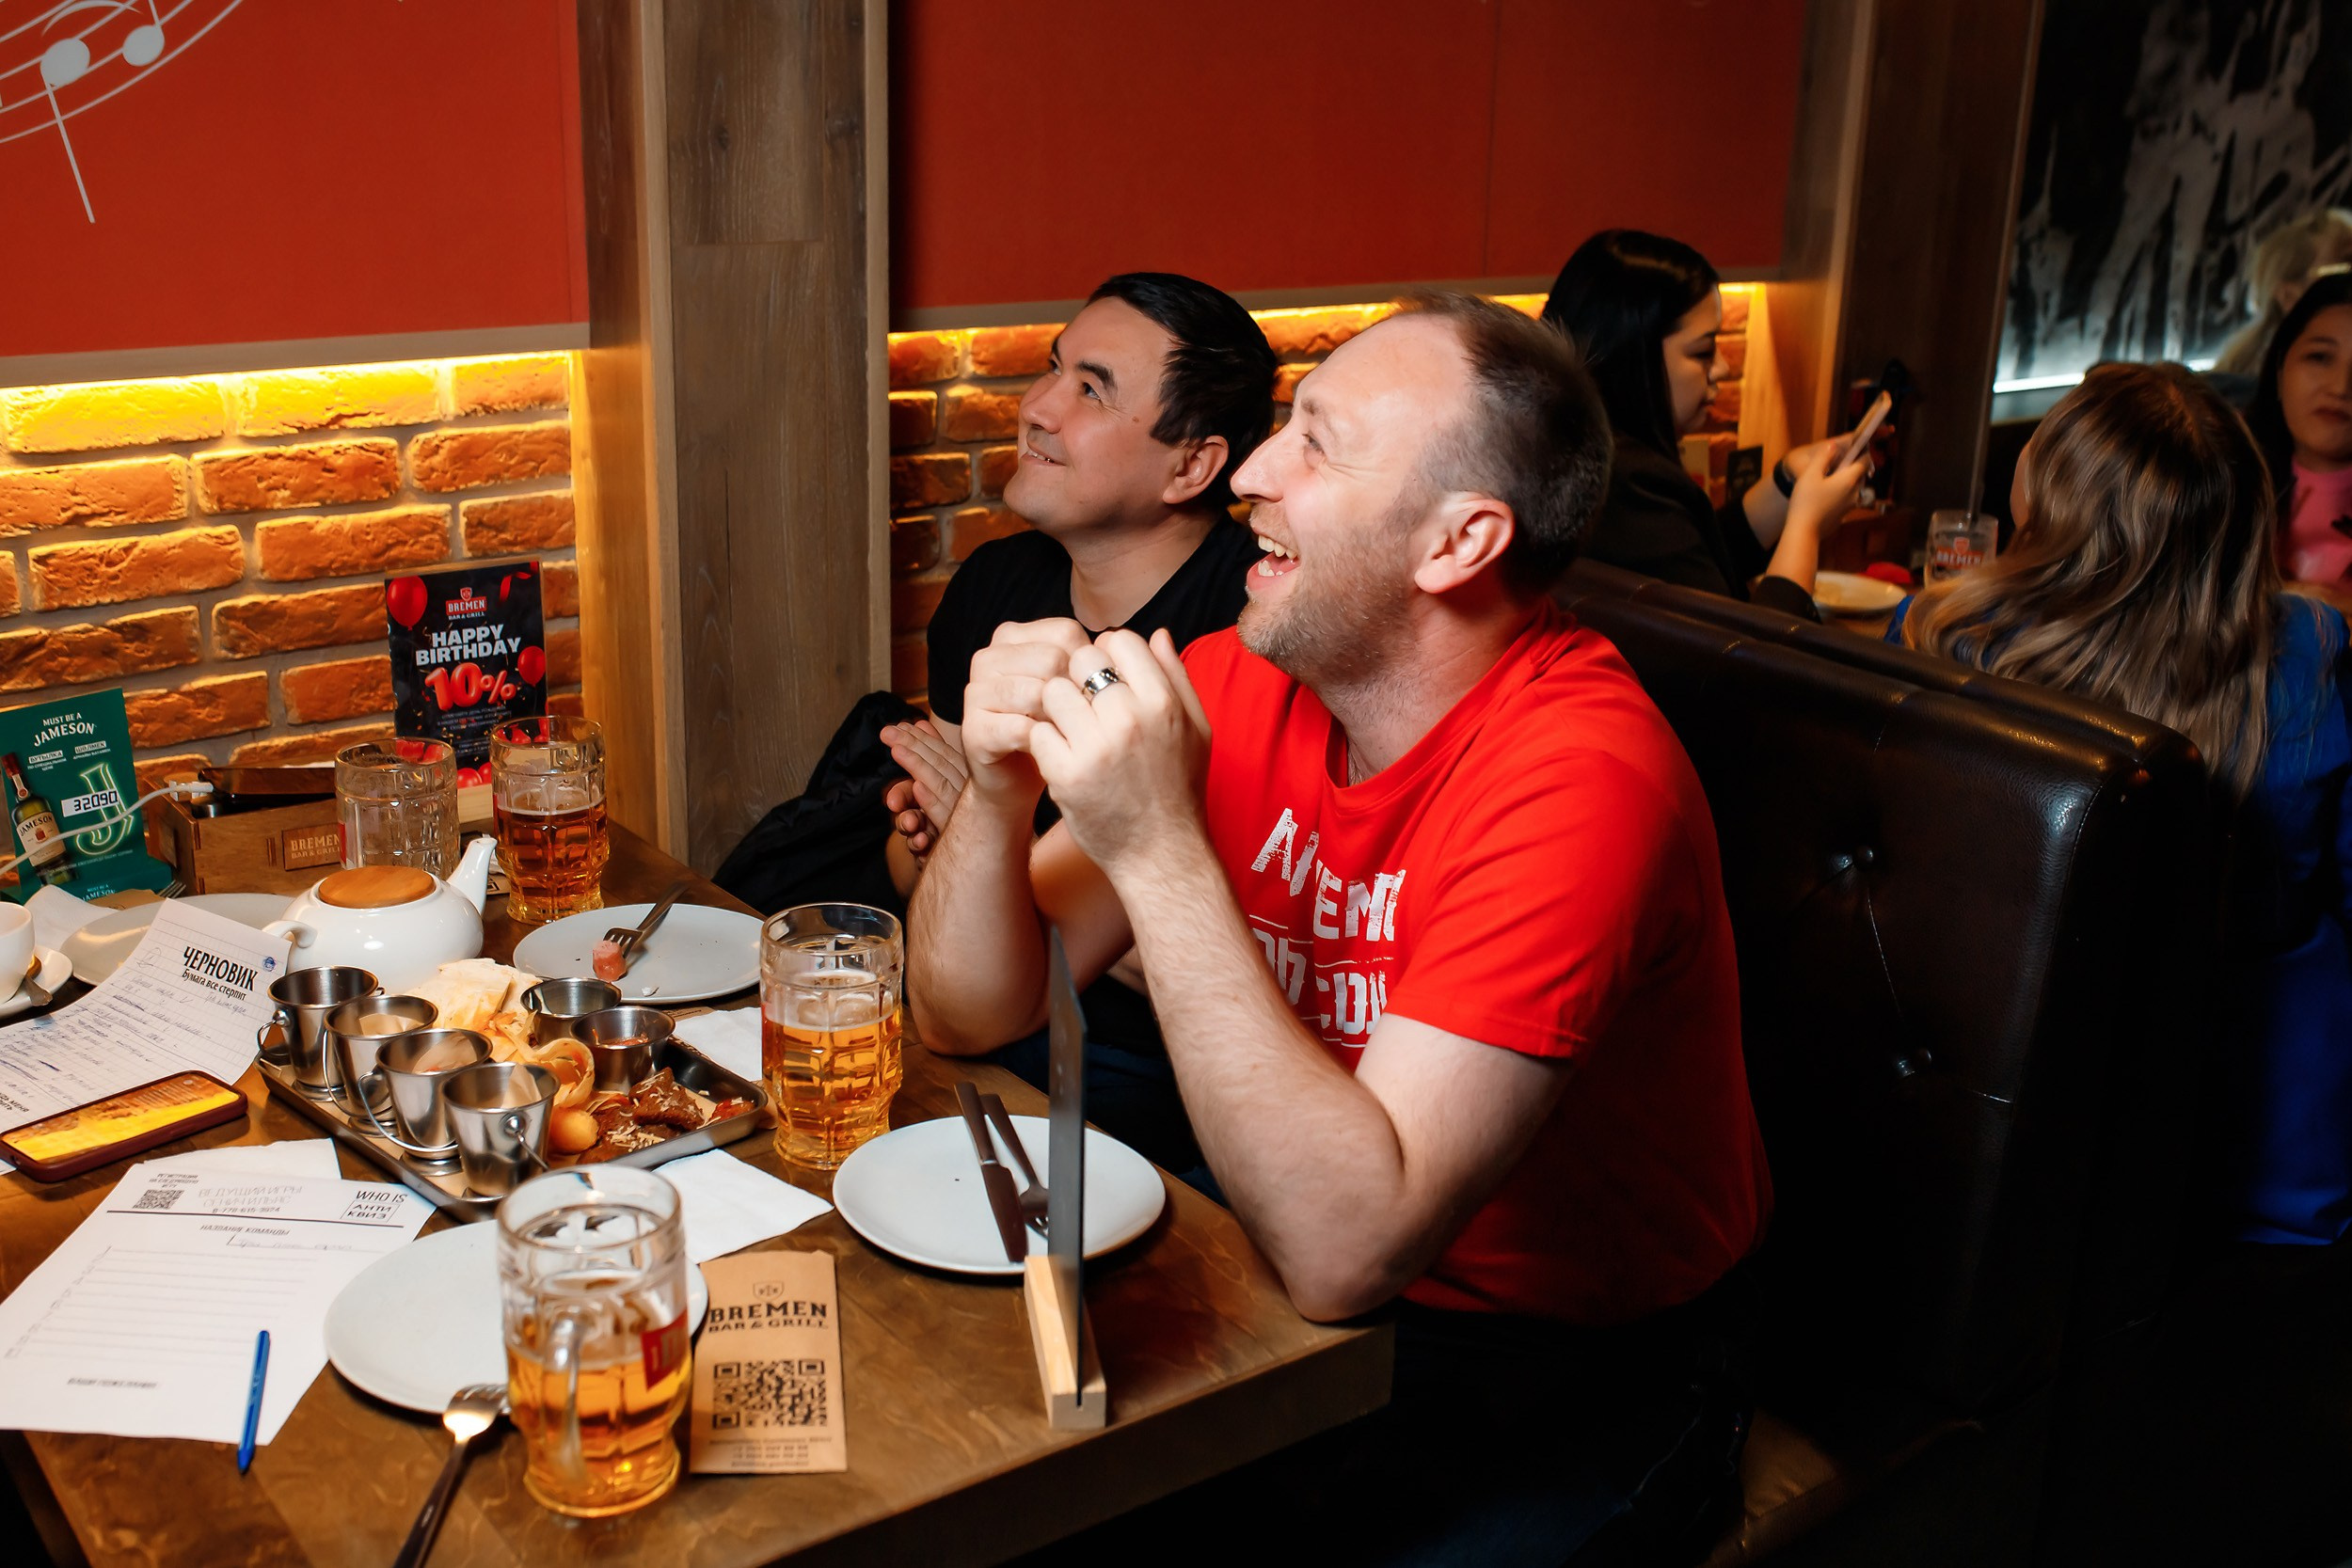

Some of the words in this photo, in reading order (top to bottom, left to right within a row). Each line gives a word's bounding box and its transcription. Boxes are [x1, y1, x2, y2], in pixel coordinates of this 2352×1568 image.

[448, 599, 485, 612] BREMEN
[432, 624, 504, 647] HAPPY
[415, 637, 521, 666] BIRTHDAY
[424, 662, 516, 711] 10%
[42, 718, 63, 727] MUST
[34, 722, 94, 747] JAMESON
[30, 752, 62, 763] БУТЫЛКА
[73, 790, 119, 812] 32090
[19, 815, 53, 837] JAMESON
[183, 946, 258, 991] ЧЕРНОВИК
[182, 968, 206, 986] Бумага
[206, 979, 219, 990] все
[219, 985, 246, 1002] стерпит
[356, 1190, 390, 1202] WHO
[391, 1194, 407, 1203] IS
[347, 1211, 387, 1219] КВИЗ
[353, 1204, 391, 1212] АНТИ
[245, 1227, 291, 1236] КОМАНДЫ
[710, 1301, 827, 1324] BREMEN
[708, 1320, 745, 1333] BAR
[751, 1320, 763, 1329] &
[768, 1318, 829, 1330] GRILL
